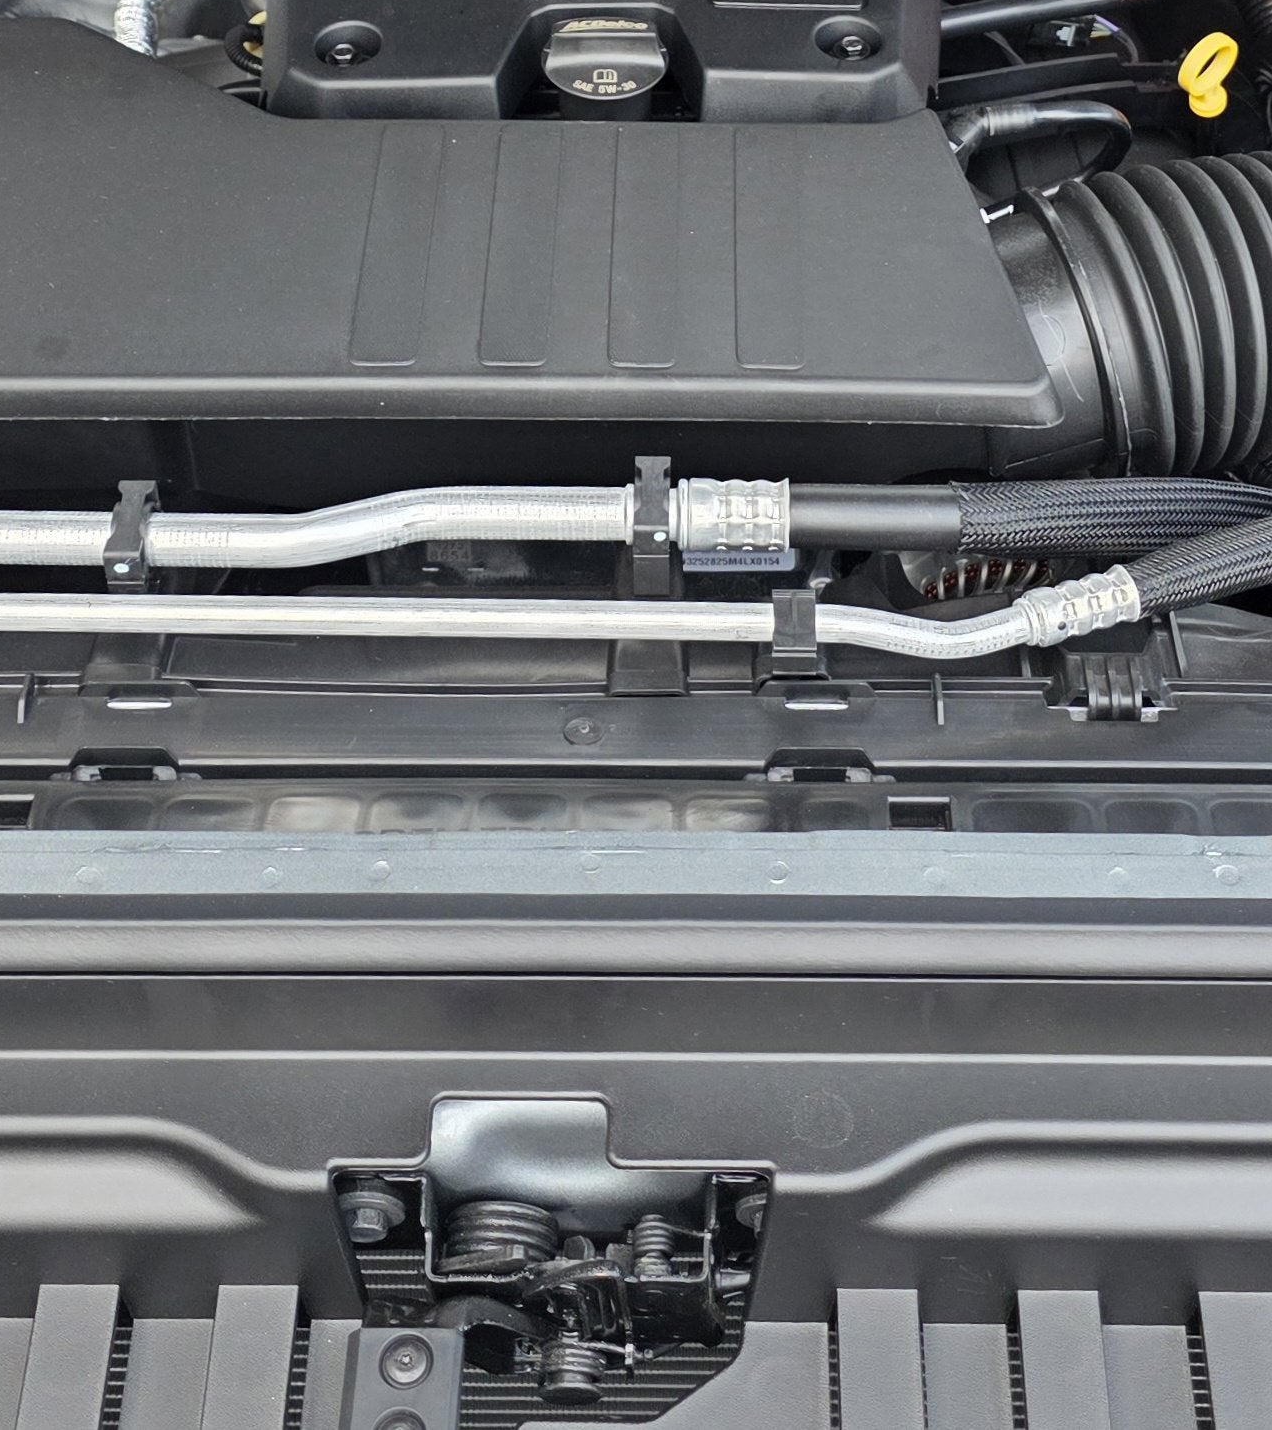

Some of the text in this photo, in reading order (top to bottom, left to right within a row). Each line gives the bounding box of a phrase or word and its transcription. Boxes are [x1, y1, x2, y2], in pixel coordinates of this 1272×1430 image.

[559, 20, 648, 32] ACDelco
[572, 79, 637, 94] SAE 5W-30
[683, 556, 780, 566] 3252825M4LX0154
